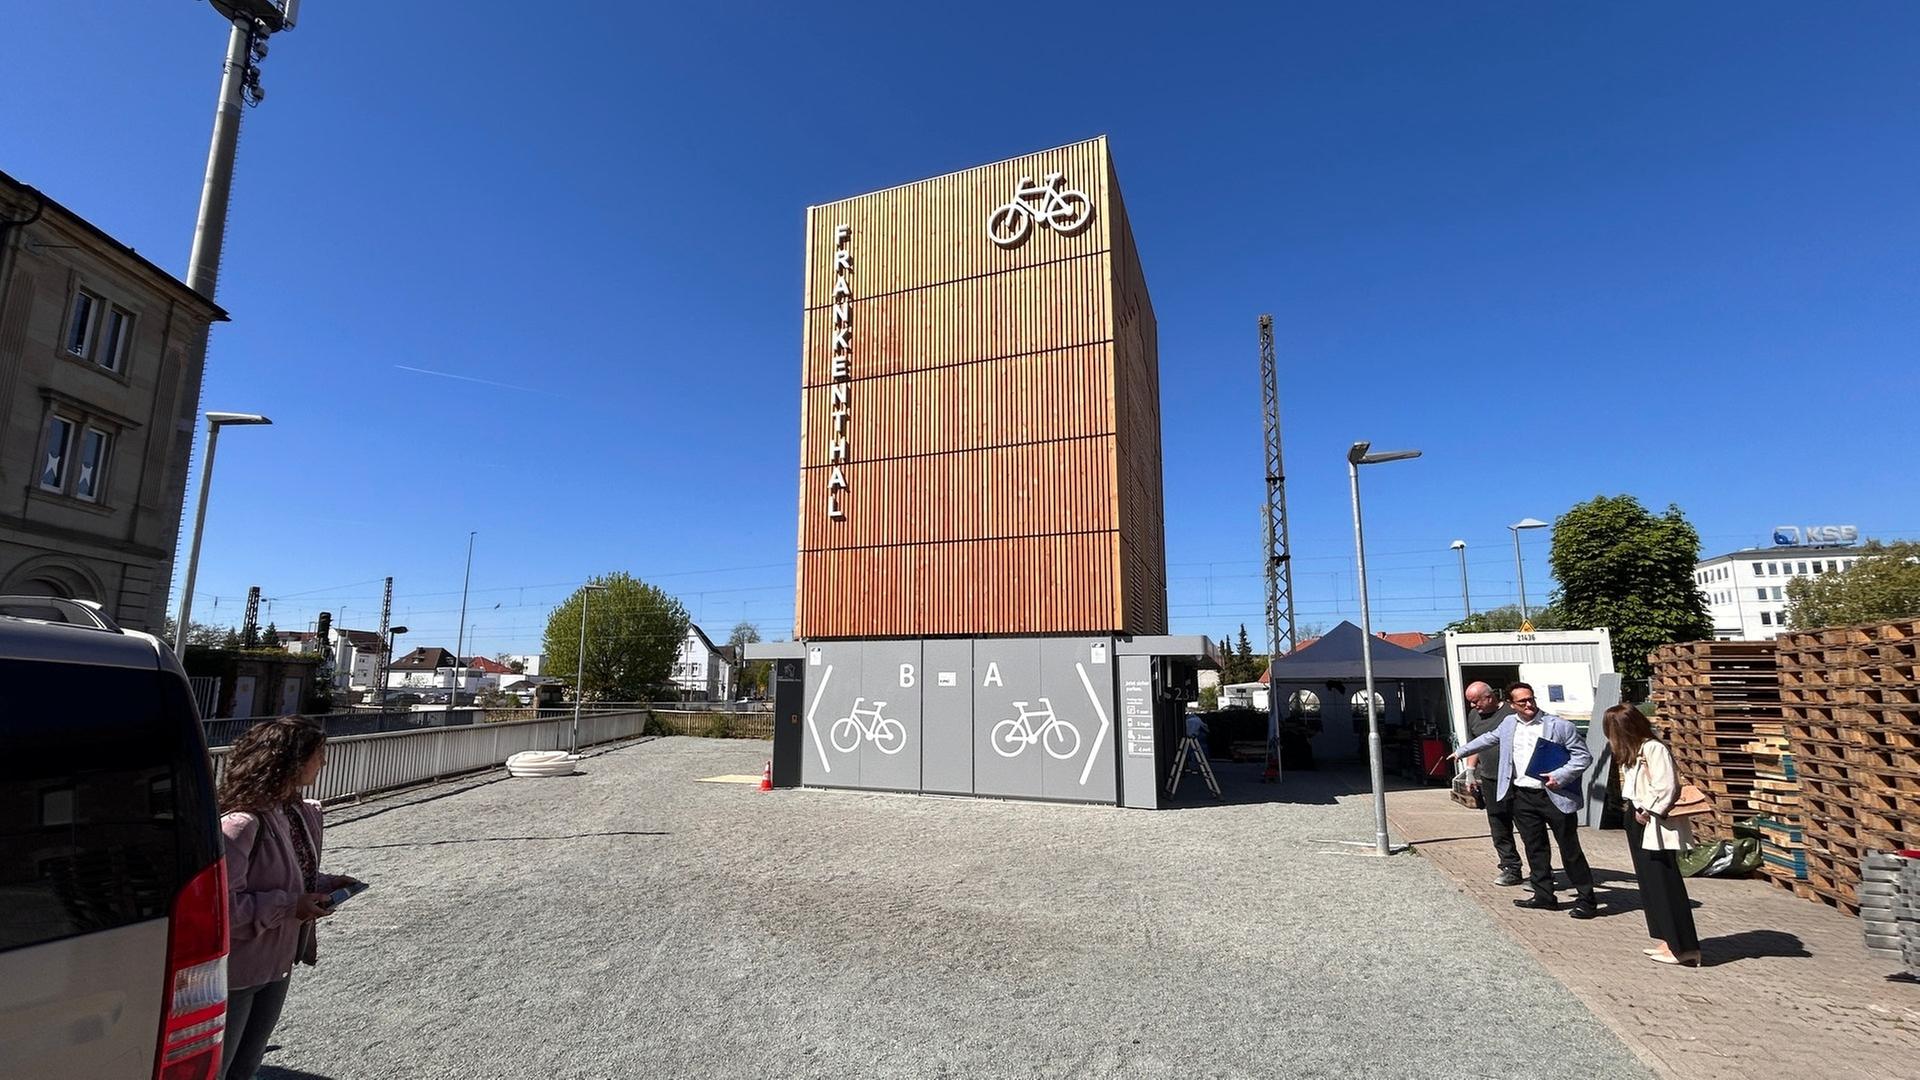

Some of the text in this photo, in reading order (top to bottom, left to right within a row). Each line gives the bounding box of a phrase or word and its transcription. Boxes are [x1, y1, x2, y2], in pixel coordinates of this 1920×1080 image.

[828, 224, 850, 520] FRANKENTHAL
[1807, 525, 1857, 542] KSB
[900, 663, 915, 688] B
[983, 662, 1004, 687] A
